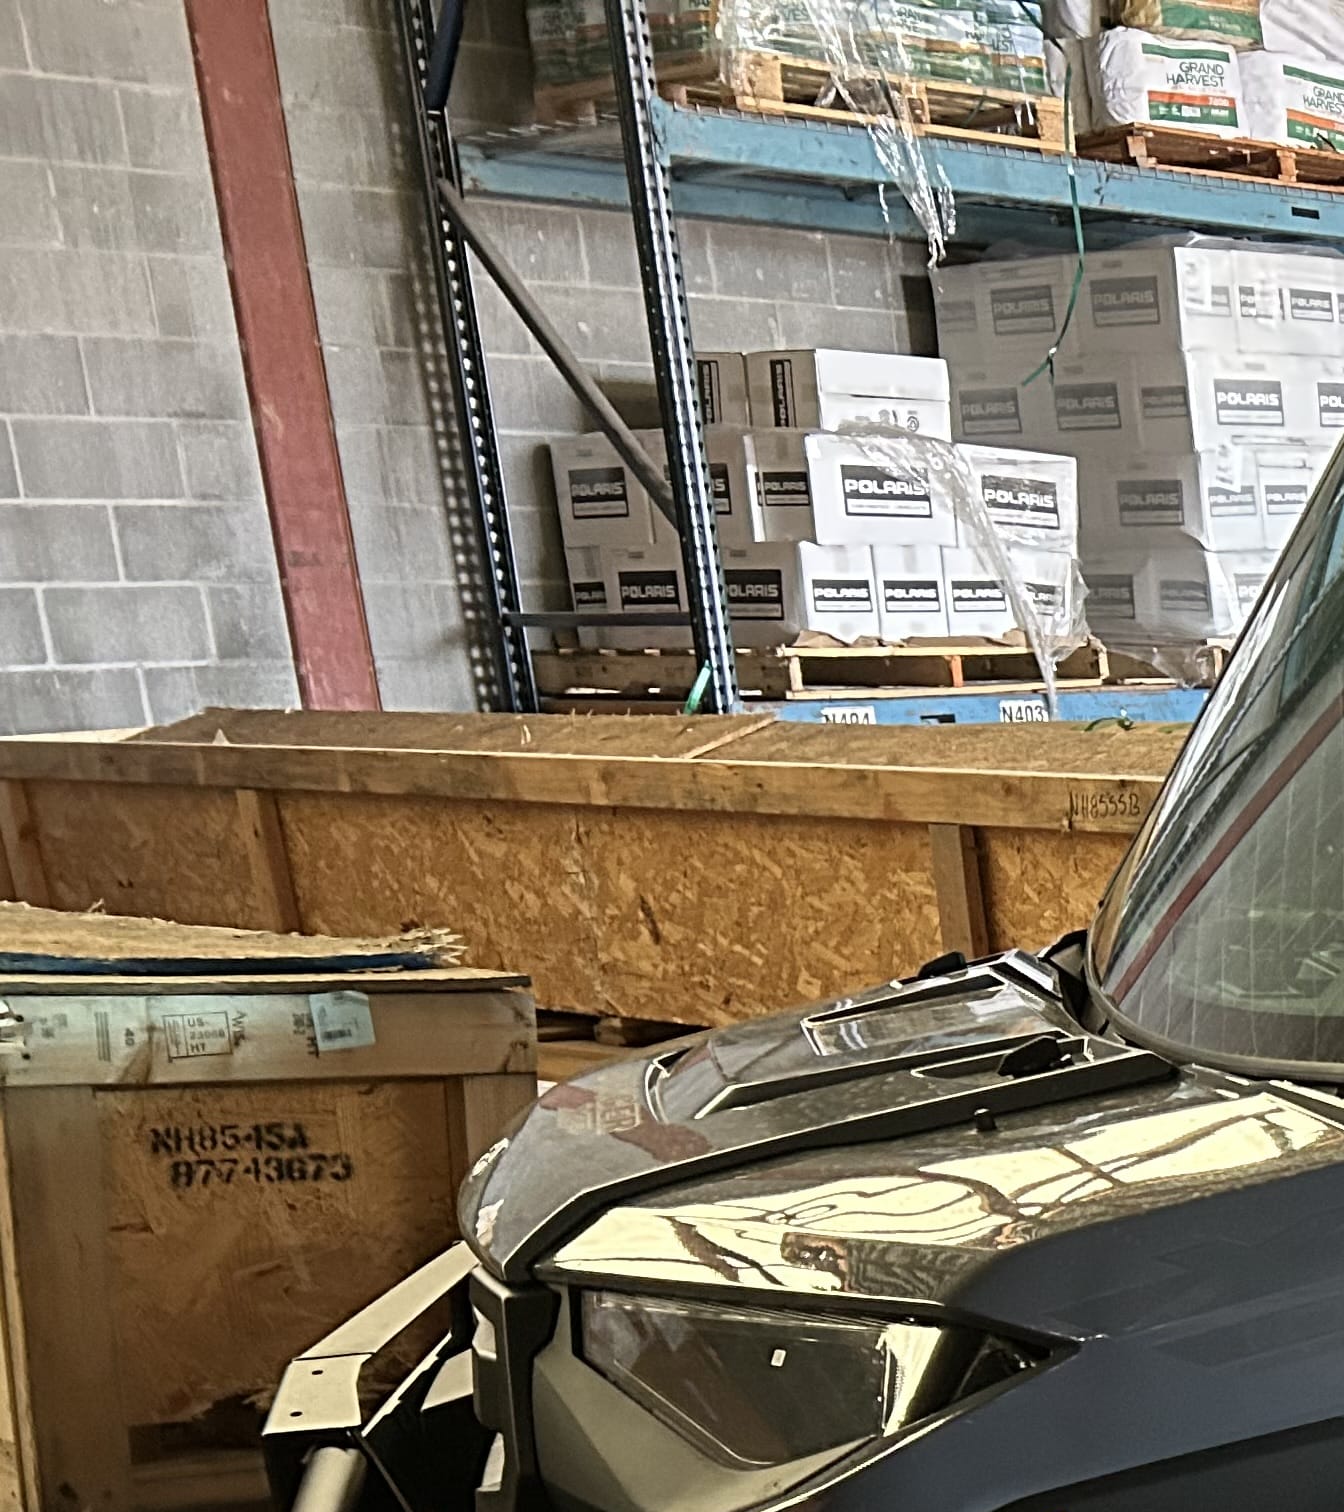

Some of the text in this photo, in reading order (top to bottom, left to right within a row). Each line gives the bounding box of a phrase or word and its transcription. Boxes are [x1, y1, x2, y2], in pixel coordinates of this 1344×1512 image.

[1179, 61, 1225, 76] GRAND
[1165, 73, 1226, 89] HARVEST
[1093, 290, 1156, 306] POLARIS
[1292, 297, 1331, 308] POLARIS
[703, 361, 714, 421] OLARIS
[1217, 392, 1280, 407] POLARIS
[962, 401, 1016, 417] POLARIS
[571, 482, 624, 496] POLARIS
[765, 481, 807, 491] POLARIS
[844, 479, 929, 497] POLARIS
[984, 488, 1055, 509] POLARIS
[621, 584, 676, 599] POLARIS
[814, 587, 869, 599] POLARIS
[885, 588, 937, 600] POLARIS
[952, 588, 1003, 599] POLARIS
[1002, 705, 1045, 723] N403
[169, 1152, 355, 1190] 87743673
